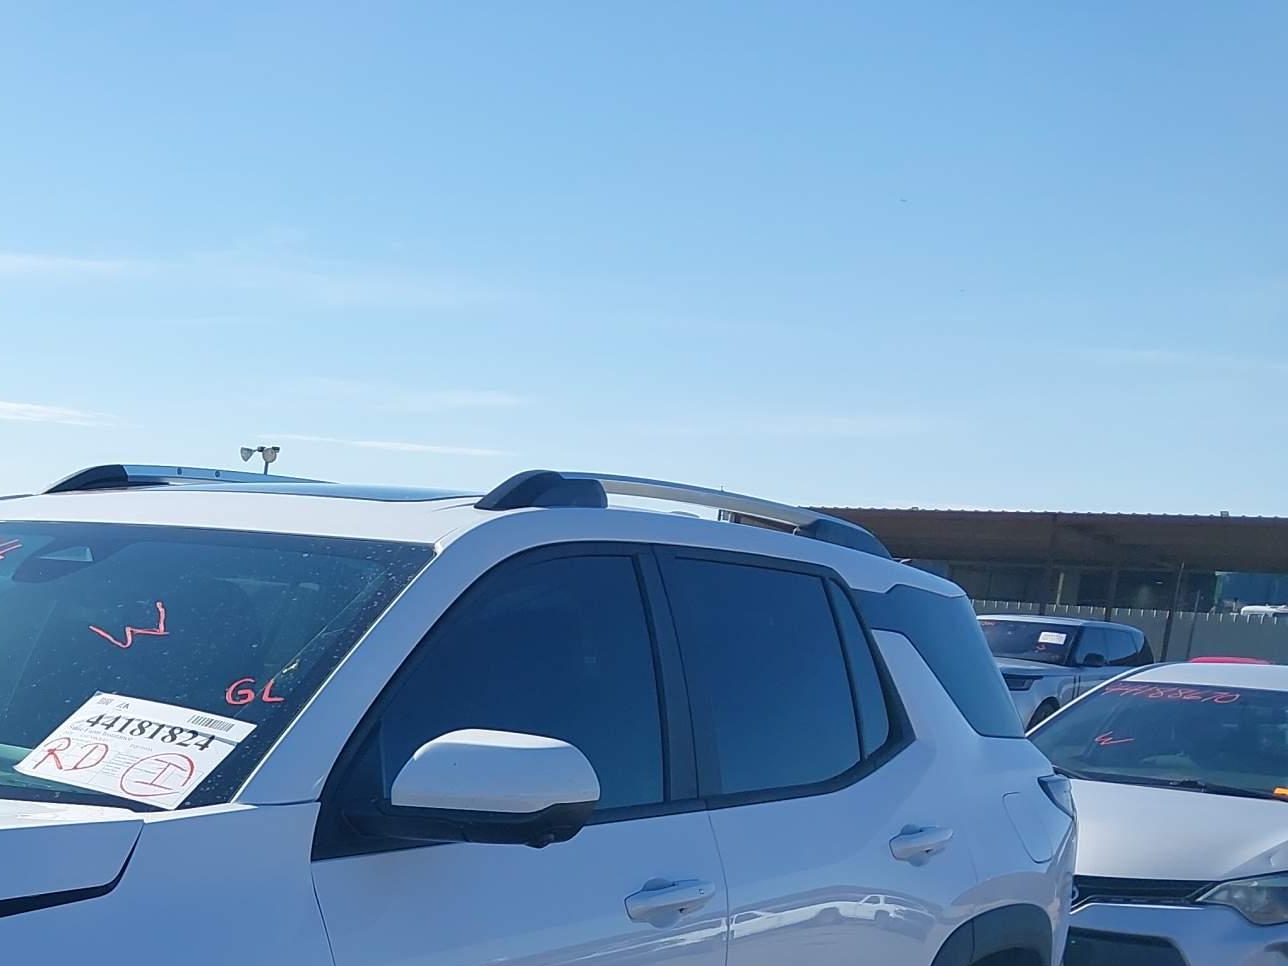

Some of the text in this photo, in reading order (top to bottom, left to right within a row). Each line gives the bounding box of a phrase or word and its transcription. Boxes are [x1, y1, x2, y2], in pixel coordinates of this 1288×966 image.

[224, 677, 285, 705] GL
[86, 713, 215, 751] 44181824
[32, 736, 109, 772] RD
